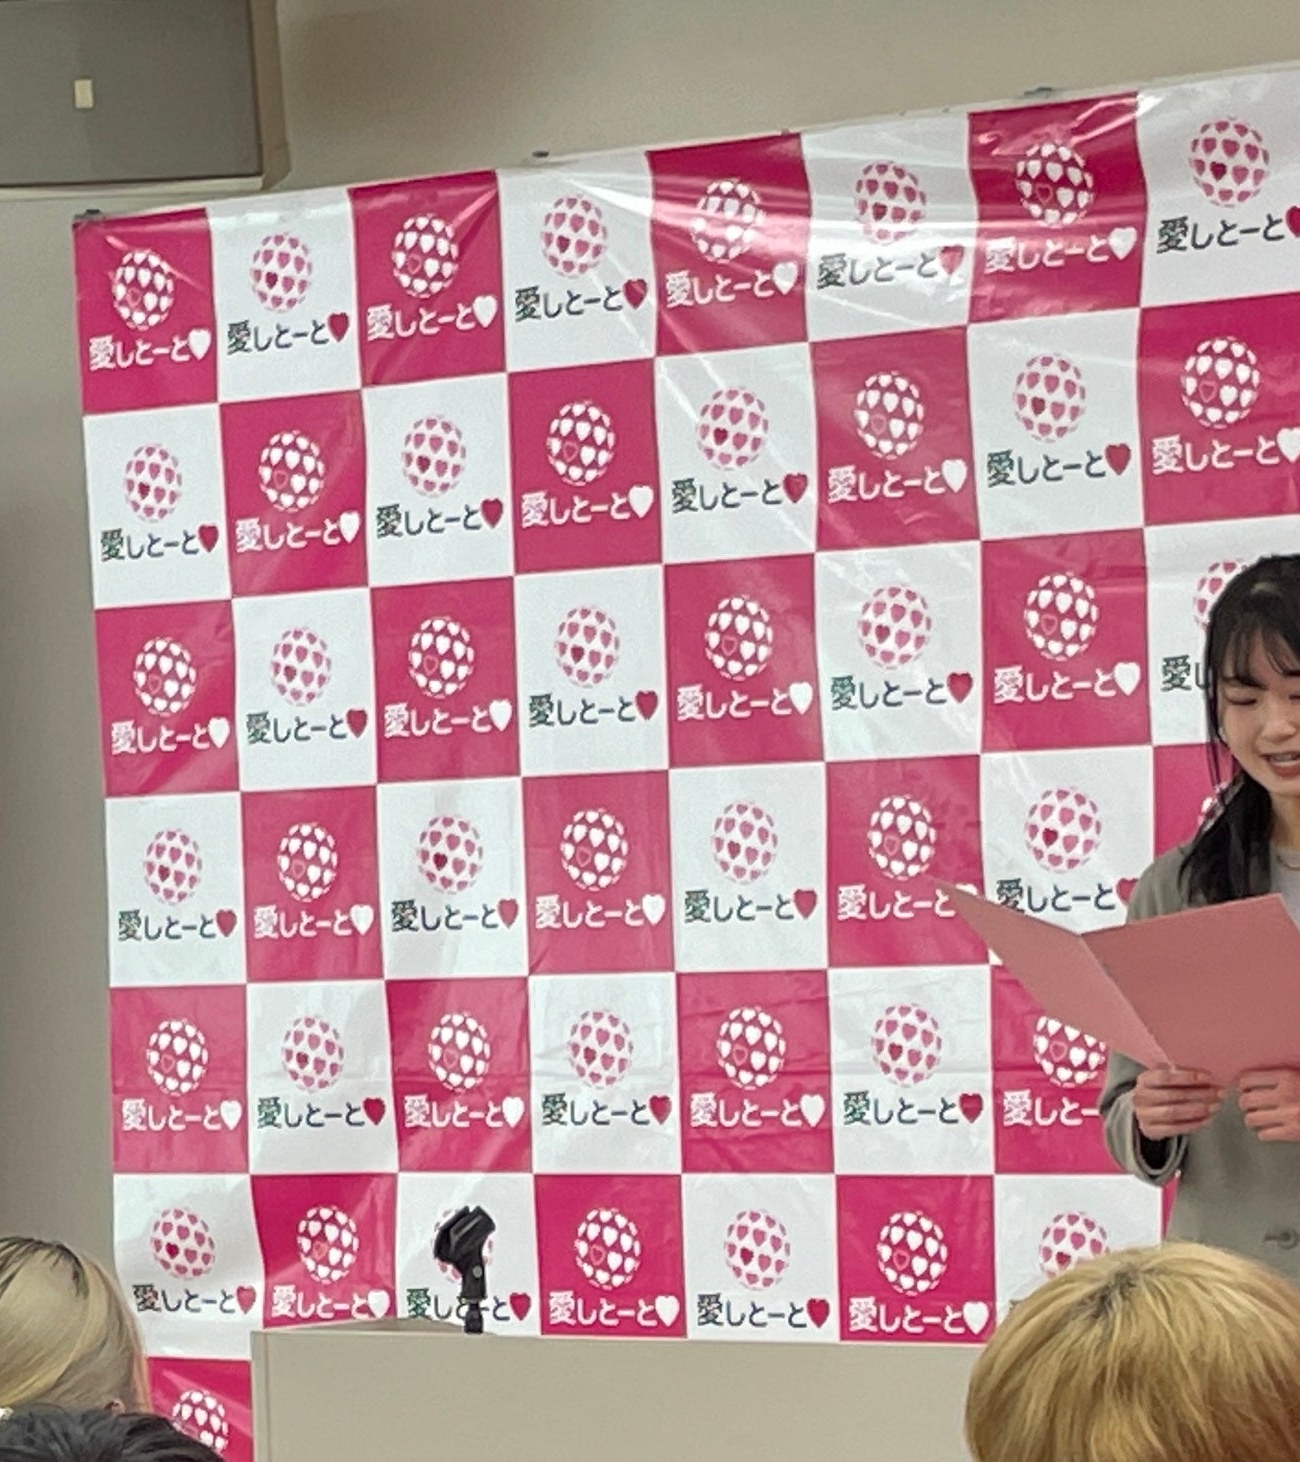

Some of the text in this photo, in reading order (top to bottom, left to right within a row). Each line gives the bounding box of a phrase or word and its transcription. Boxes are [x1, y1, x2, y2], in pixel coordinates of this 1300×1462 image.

[1157, 214, 1286, 253] 愛しとーと
[817, 251, 943, 289] 愛しとーと
[984, 236, 1113, 274] 愛しとーと
[515, 284, 624, 321] 愛しとーと
[666, 270, 775, 306] 愛しとーと
[228, 321, 328, 353] 愛しとーと
[368, 302, 474, 339] 愛しとーと
[89, 333, 190, 370] 愛しとーと
[987, 450, 1107, 487] 愛しとーと
[1153, 431, 1279, 474] 愛しとーと
[673, 476, 784, 513] 愛しとーと
[828, 465, 943, 502] 愛しとーと
[377, 503, 483, 536] 愛しとーと
[522, 490, 631, 527] 愛しとーと
[100, 526, 199, 561] 愛しとーと
[236, 517, 341, 553] 愛しとーと
[678, 683, 789, 719] 愛しとーと
[830, 676, 948, 710] 愛しとーと
[994, 666, 1114, 704] 愛しとーと
[385, 701, 491, 738] 愛しとーと
[529, 691, 637, 726] 愛しとーと
[112, 720, 211, 754] 愛しとーと
[247, 708, 348, 745] 愛しとーと
[536, 895, 643, 929] 愛しとーと
[685, 889, 795, 923] 愛しとーと
[838, 884, 954, 920] 愛しとーと
[997, 878, 1115, 912] 愛しとーと
[118, 907, 218, 941] 愛しとーと
[254, 902, 351, 937] 愛しとーと
[392, 898, 499, 931] 愛しとーと
[123, 1098, 221, 1131] 愛しとーと
[257, 1096, 365, 1128] 愛しとーと
[405, 1096, 504, 1130] 愛しとーと
[542, 1094, 652, 1125] 愛しとーと
[690, 1094, 799, 1128] 愛しとーと
[844, 1091, 959, 1126] 愛しとーと
[1003, 1089, 1099, 1127] 愛しとー
[133, 1283, 237, 1314] 愛しとーと
[272, 1287, 371, 1320] 愛しとーと
[407, 1288, 510, 1320] 愛しとと
[549, 1292, 656, 1326] 愛しとーと
[697, 1294, 806, 1327] 愛しとーと
[848, 1296, 967, 1334] 愛しとーと
